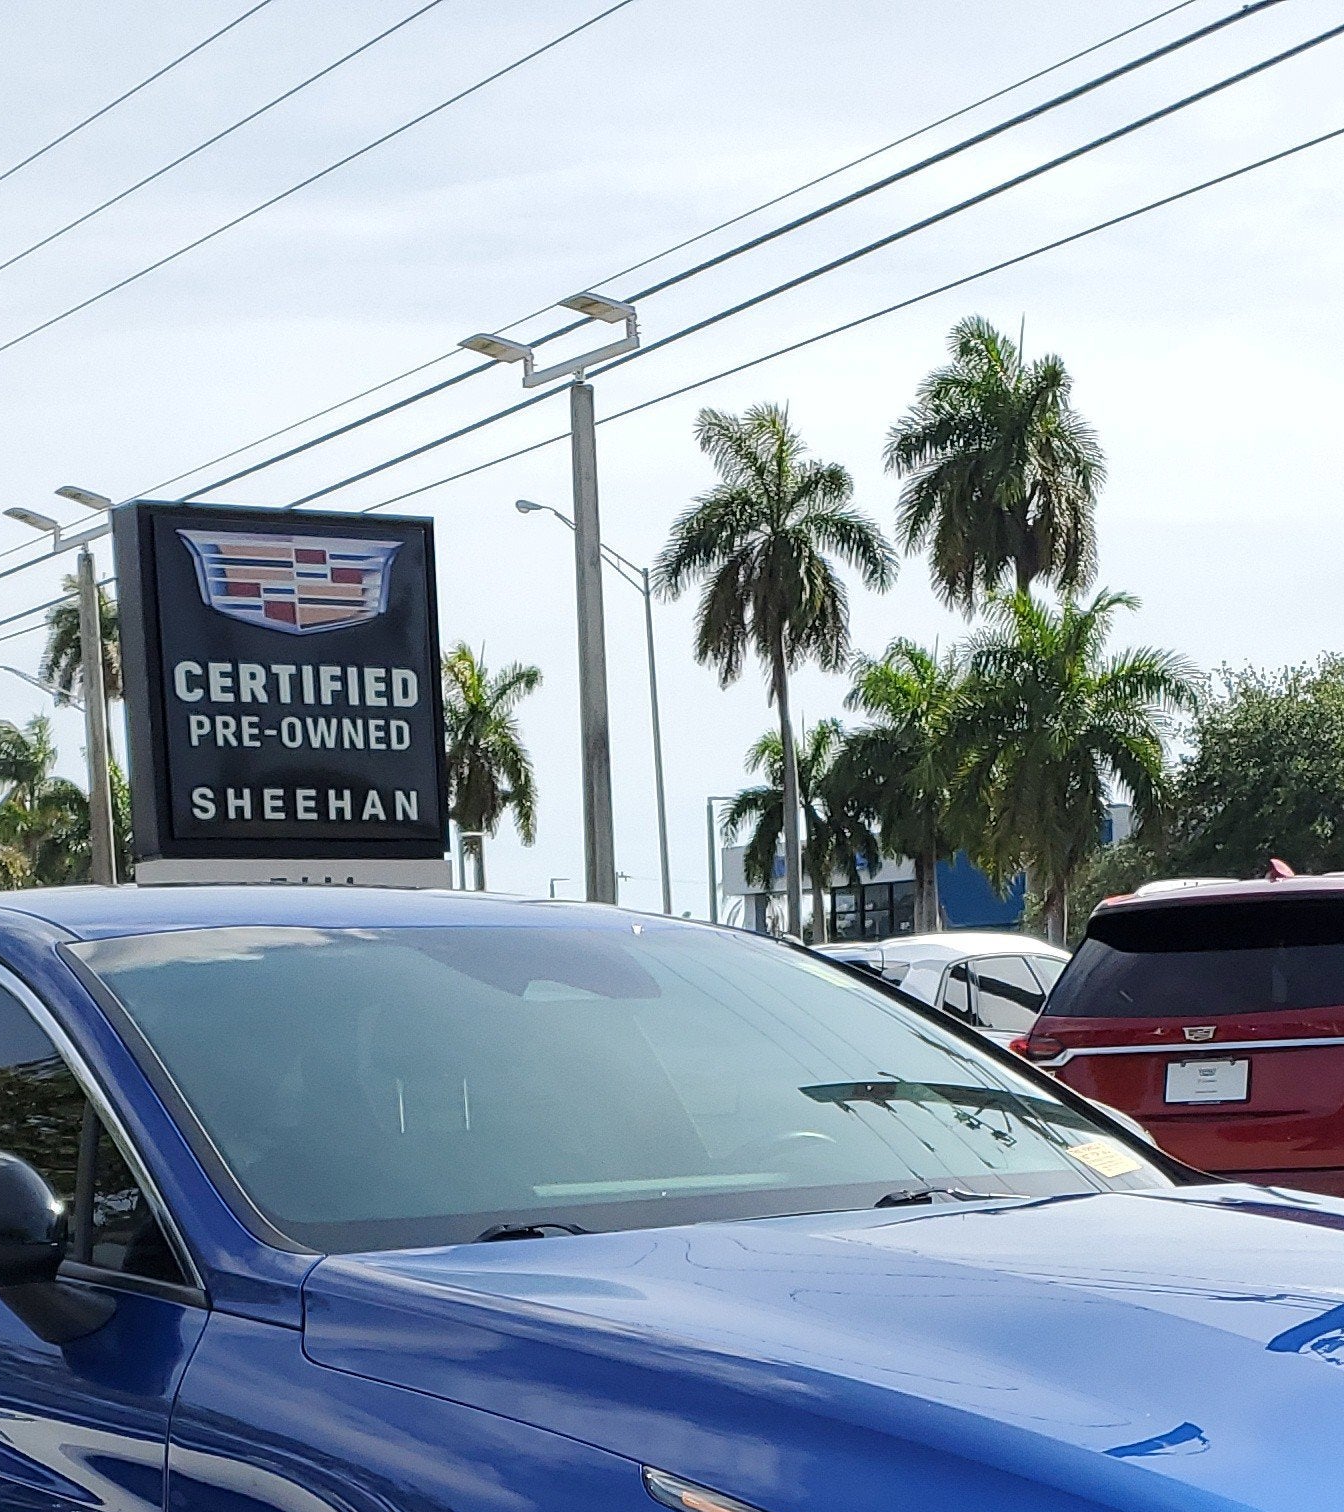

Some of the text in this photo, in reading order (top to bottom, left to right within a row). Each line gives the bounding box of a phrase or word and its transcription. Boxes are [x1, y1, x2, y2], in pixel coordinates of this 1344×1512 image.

[174, 660, 418, 708] CERTIFIED
[190, 715, 411, 751] PRE-OWNED
[192, 786, 419, 820] SHEEHAN
